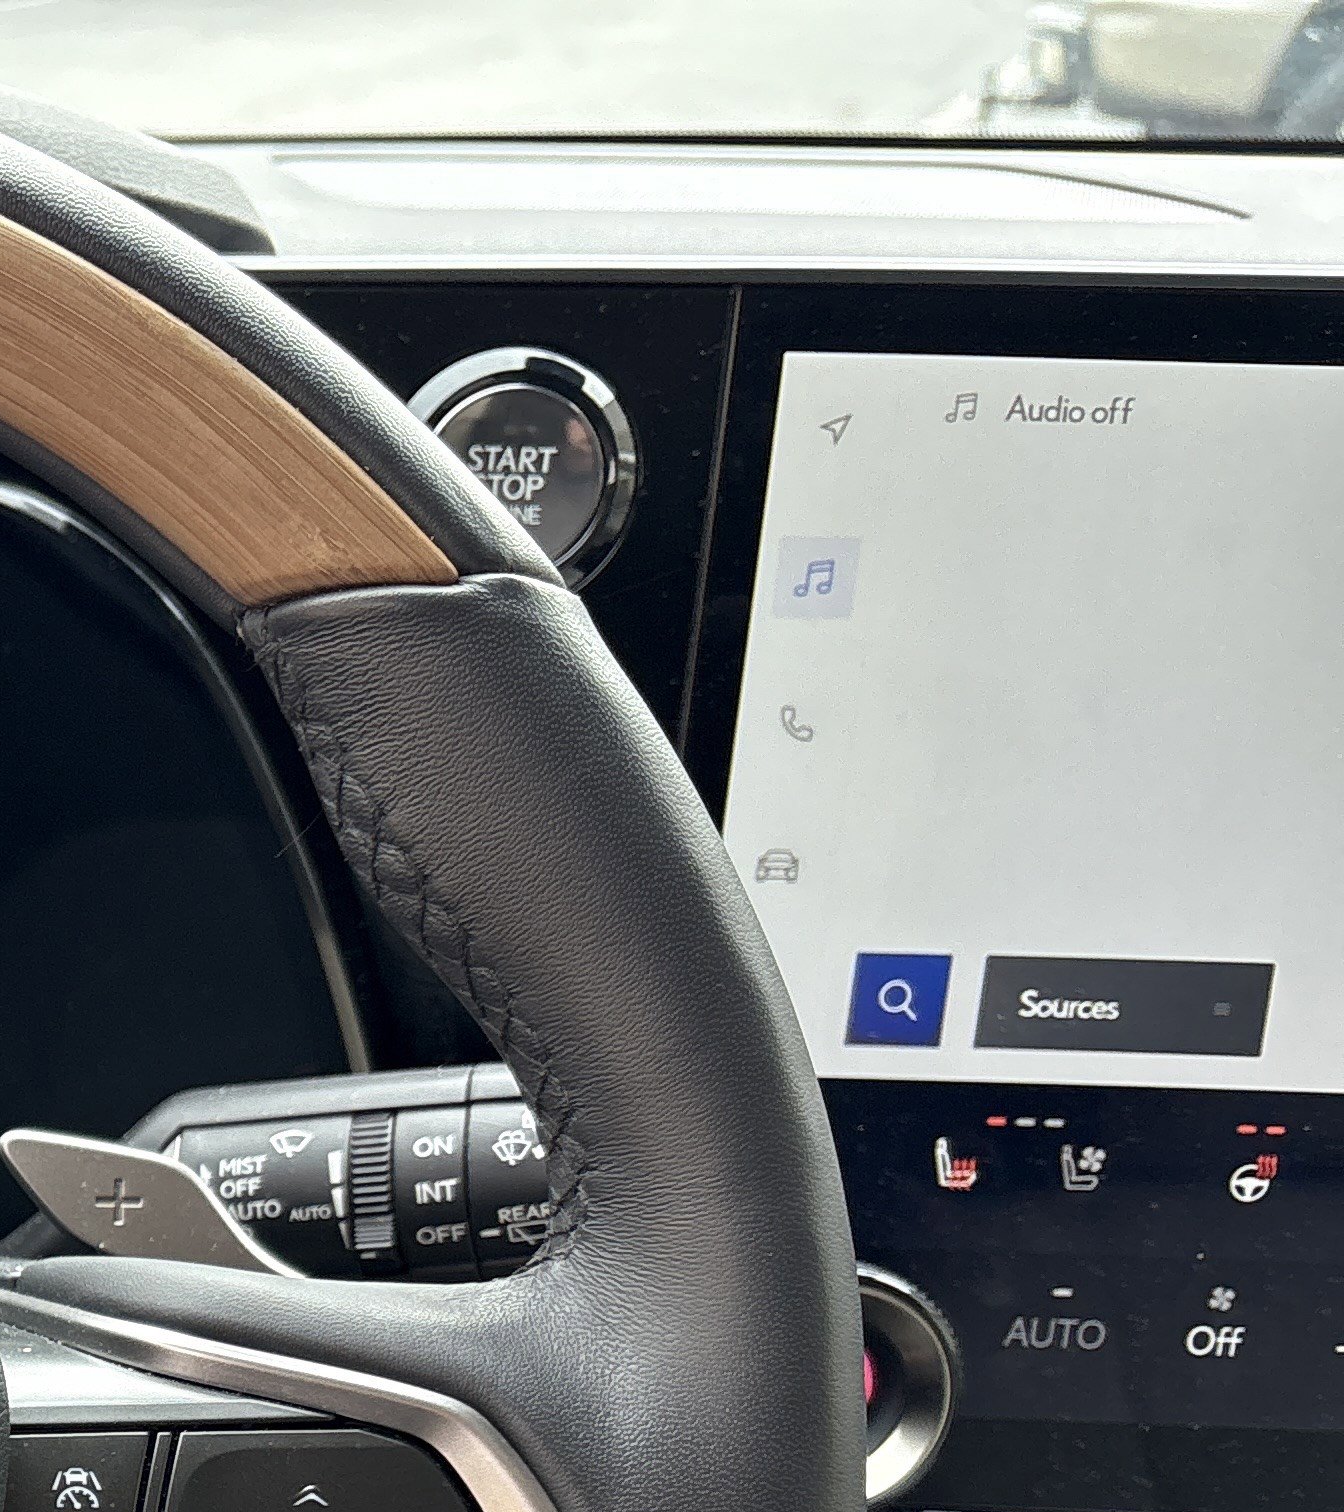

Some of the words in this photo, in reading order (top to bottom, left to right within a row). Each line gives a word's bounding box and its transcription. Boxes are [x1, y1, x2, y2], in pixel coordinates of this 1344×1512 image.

[1006, 396, 1086, 426] Audio
[1091, 397, 1135, 426] off
[467, 444, 559, 474] START
[1017, 990, 1120, 1022] Sources
[412, 1134, 455, 1159] ON
[218, 1154, 268, 1178] MIST
[219, 1175, 262, 1199] OFF
[414, 1178, 459, 1205] INT
[288, 1203, 332, 1222] AUTO
[415, 1221, 468, 1245] OFF
[1002, 1317, 1108, 1351] AUTO
[1184, 1324, 1247, 1358] Off
